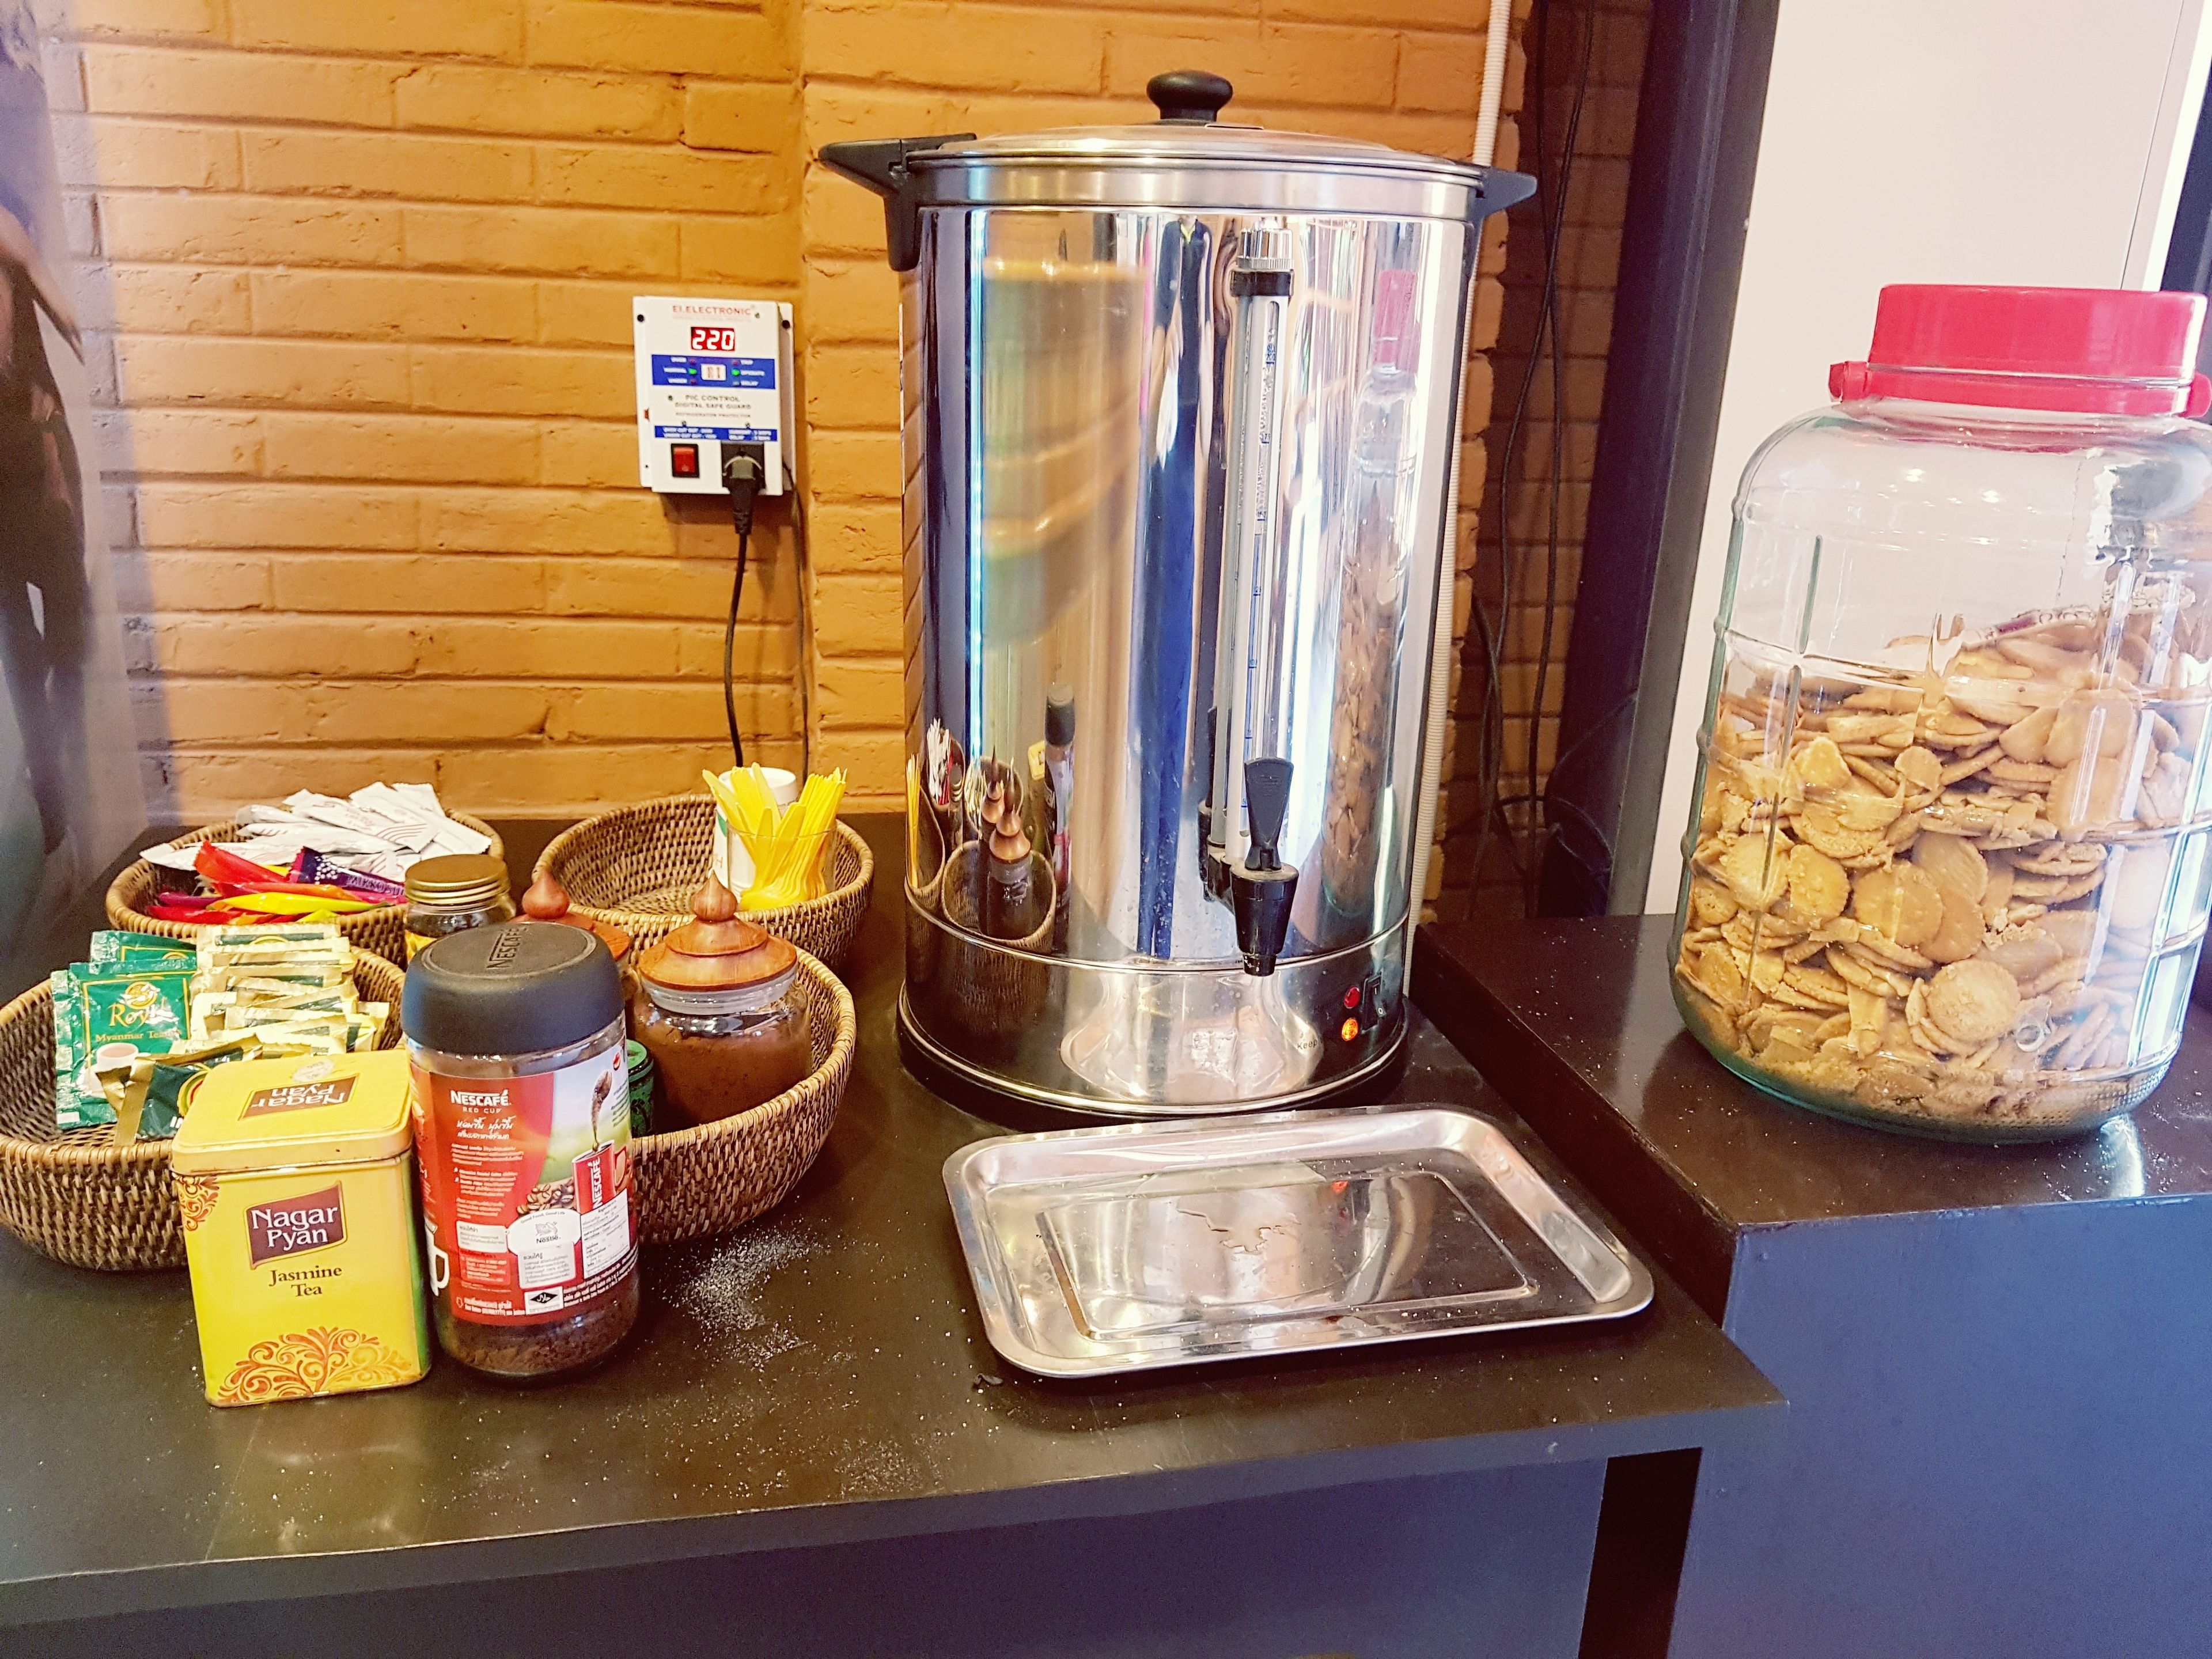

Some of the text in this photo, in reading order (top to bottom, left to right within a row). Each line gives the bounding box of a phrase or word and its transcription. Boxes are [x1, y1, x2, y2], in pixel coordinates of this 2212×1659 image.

[692, 329, 734, 350] 220
[96, 1033, 143, 1042] Myanmar
[1297, 1039, 1317, 1050] Keep
[271, 1084, 335, 1097] Pyan
[450, 1089, 509, 1107] NESCAFÉ
[251, 1093, 345, 1108] Nagar
[588, 1157, 603, 1210] NESCAFÉ
[251, 1207, 338, 1231] Nagar
[267, 1228, 328, 1251] Pyan
[268, 1265, 342, 1286] Jasmine
[291, 1283, 323, 1296] Tea
